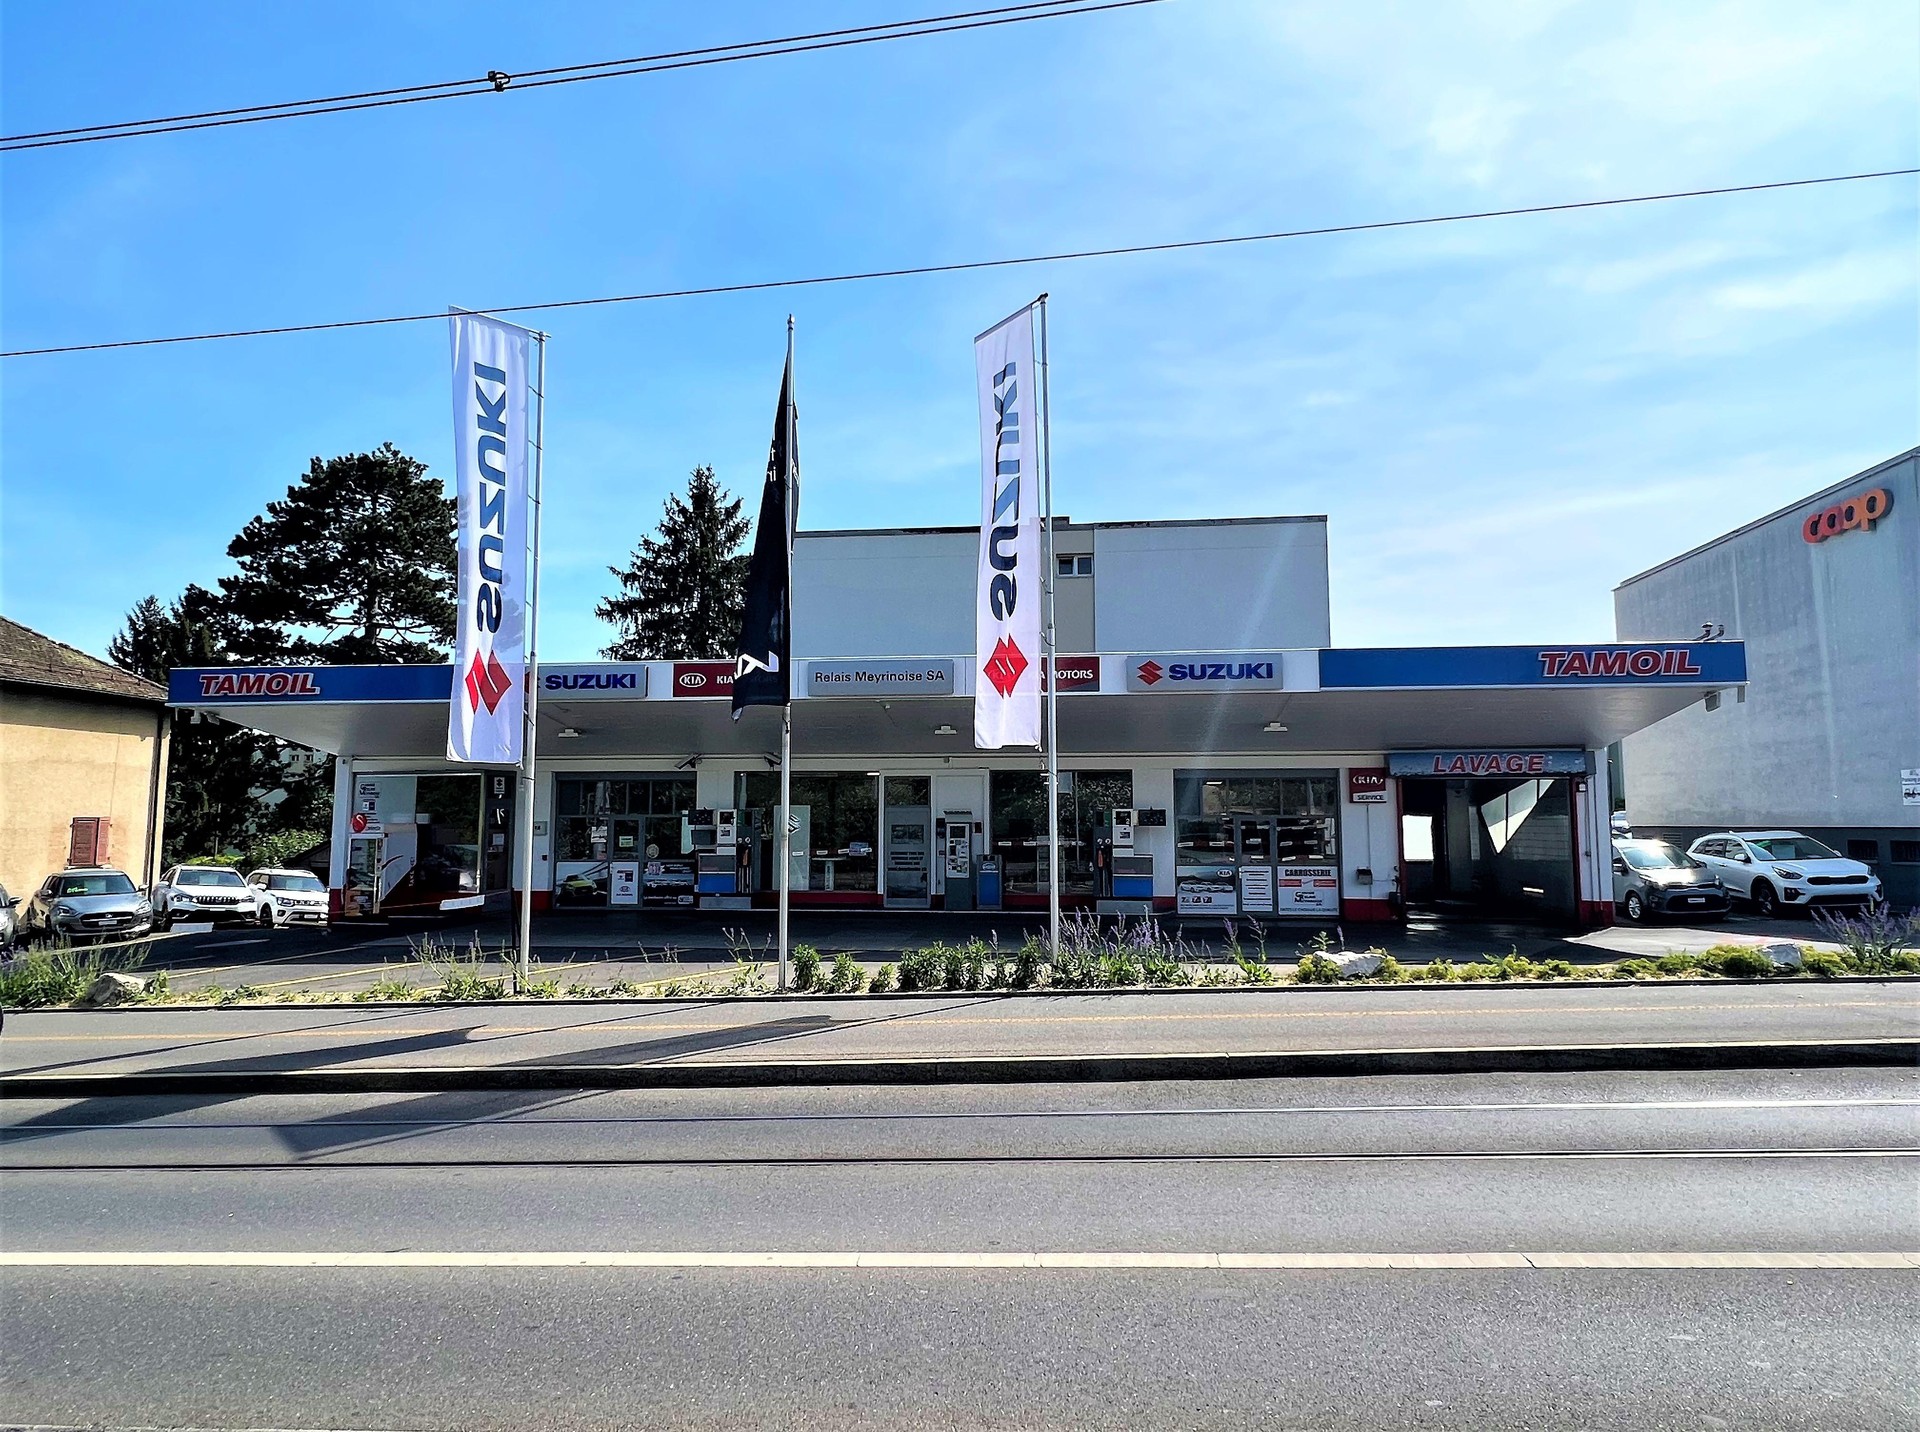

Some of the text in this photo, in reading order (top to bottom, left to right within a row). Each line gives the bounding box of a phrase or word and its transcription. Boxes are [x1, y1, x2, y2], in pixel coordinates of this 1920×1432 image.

[1802, 487, 1894, 544] coop
[1168, 662, 1274, 681] SUZUKI
[1537, 648, 1702, 678] TAMOIL
[199, 672, 321, 696] TAMOIL
[544, 673, 637, 690] SUZUKI
[682, 675, 703, 685] KIA
[815, 669, 945, 684] Relais Meyrinoise SA
[1432, 753, 1546, 774] LAVAGE
[1356, 775, 1381, 785] KIA
[1284, 868, 1332, 877] CARROSSERIE
